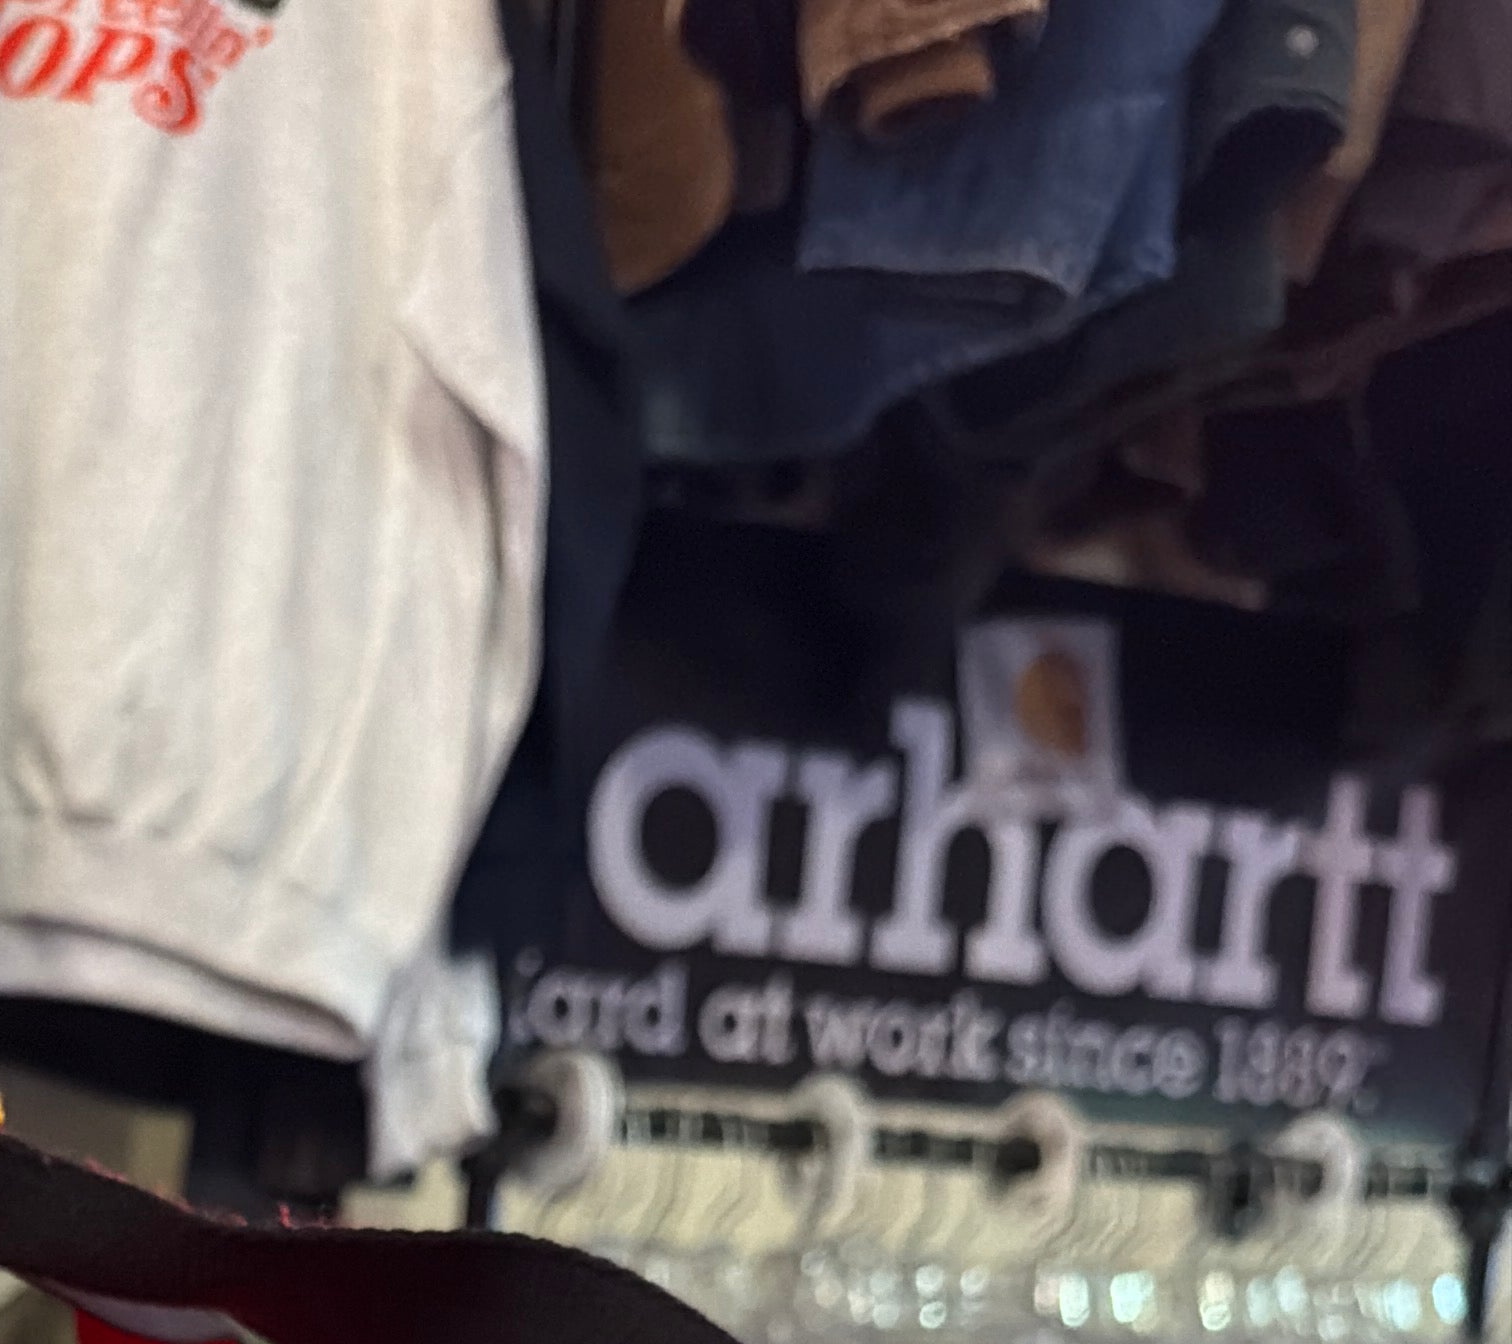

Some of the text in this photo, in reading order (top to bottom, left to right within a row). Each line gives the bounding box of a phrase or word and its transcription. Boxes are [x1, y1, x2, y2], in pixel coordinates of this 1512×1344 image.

[586, 696, 1456, 1026] arhartt
[510, 946, 687, 1058] ard
[697, 971, 796, 1065] at
[804, 986, 1005, 1082] work
[1005, 999, 1208, 1099] since
